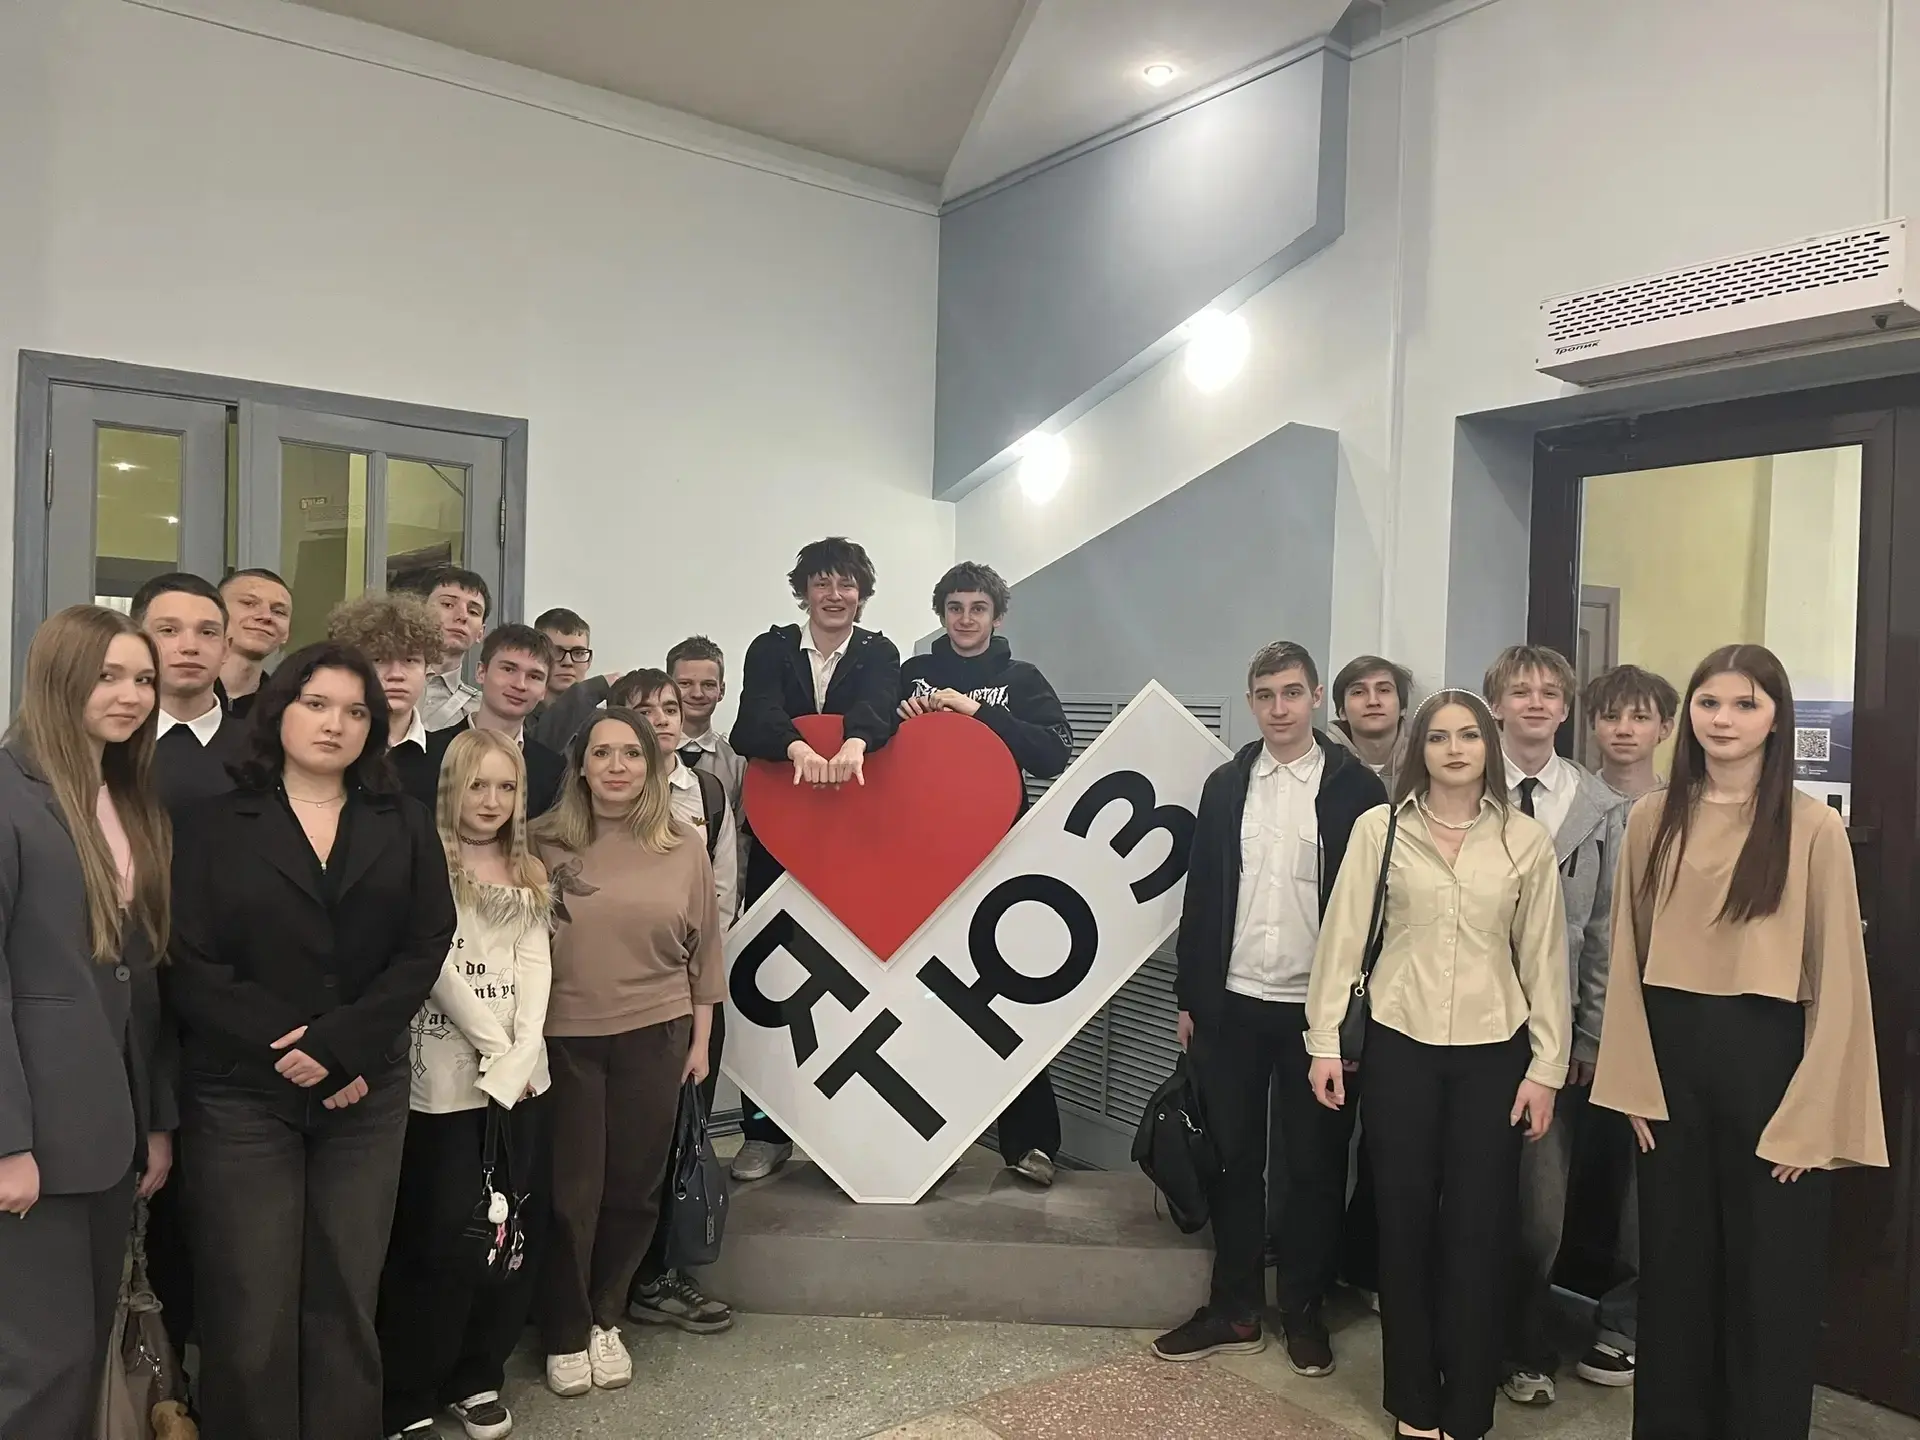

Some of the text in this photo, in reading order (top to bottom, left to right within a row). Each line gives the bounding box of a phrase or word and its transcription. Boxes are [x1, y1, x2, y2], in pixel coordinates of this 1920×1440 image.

[466, 960, 485, 975] do
[729, 908, 870, 1068] Я
[814, 770, 1198, 1141] ТЮЗ
[429, 1013, 455, 1025] ar
